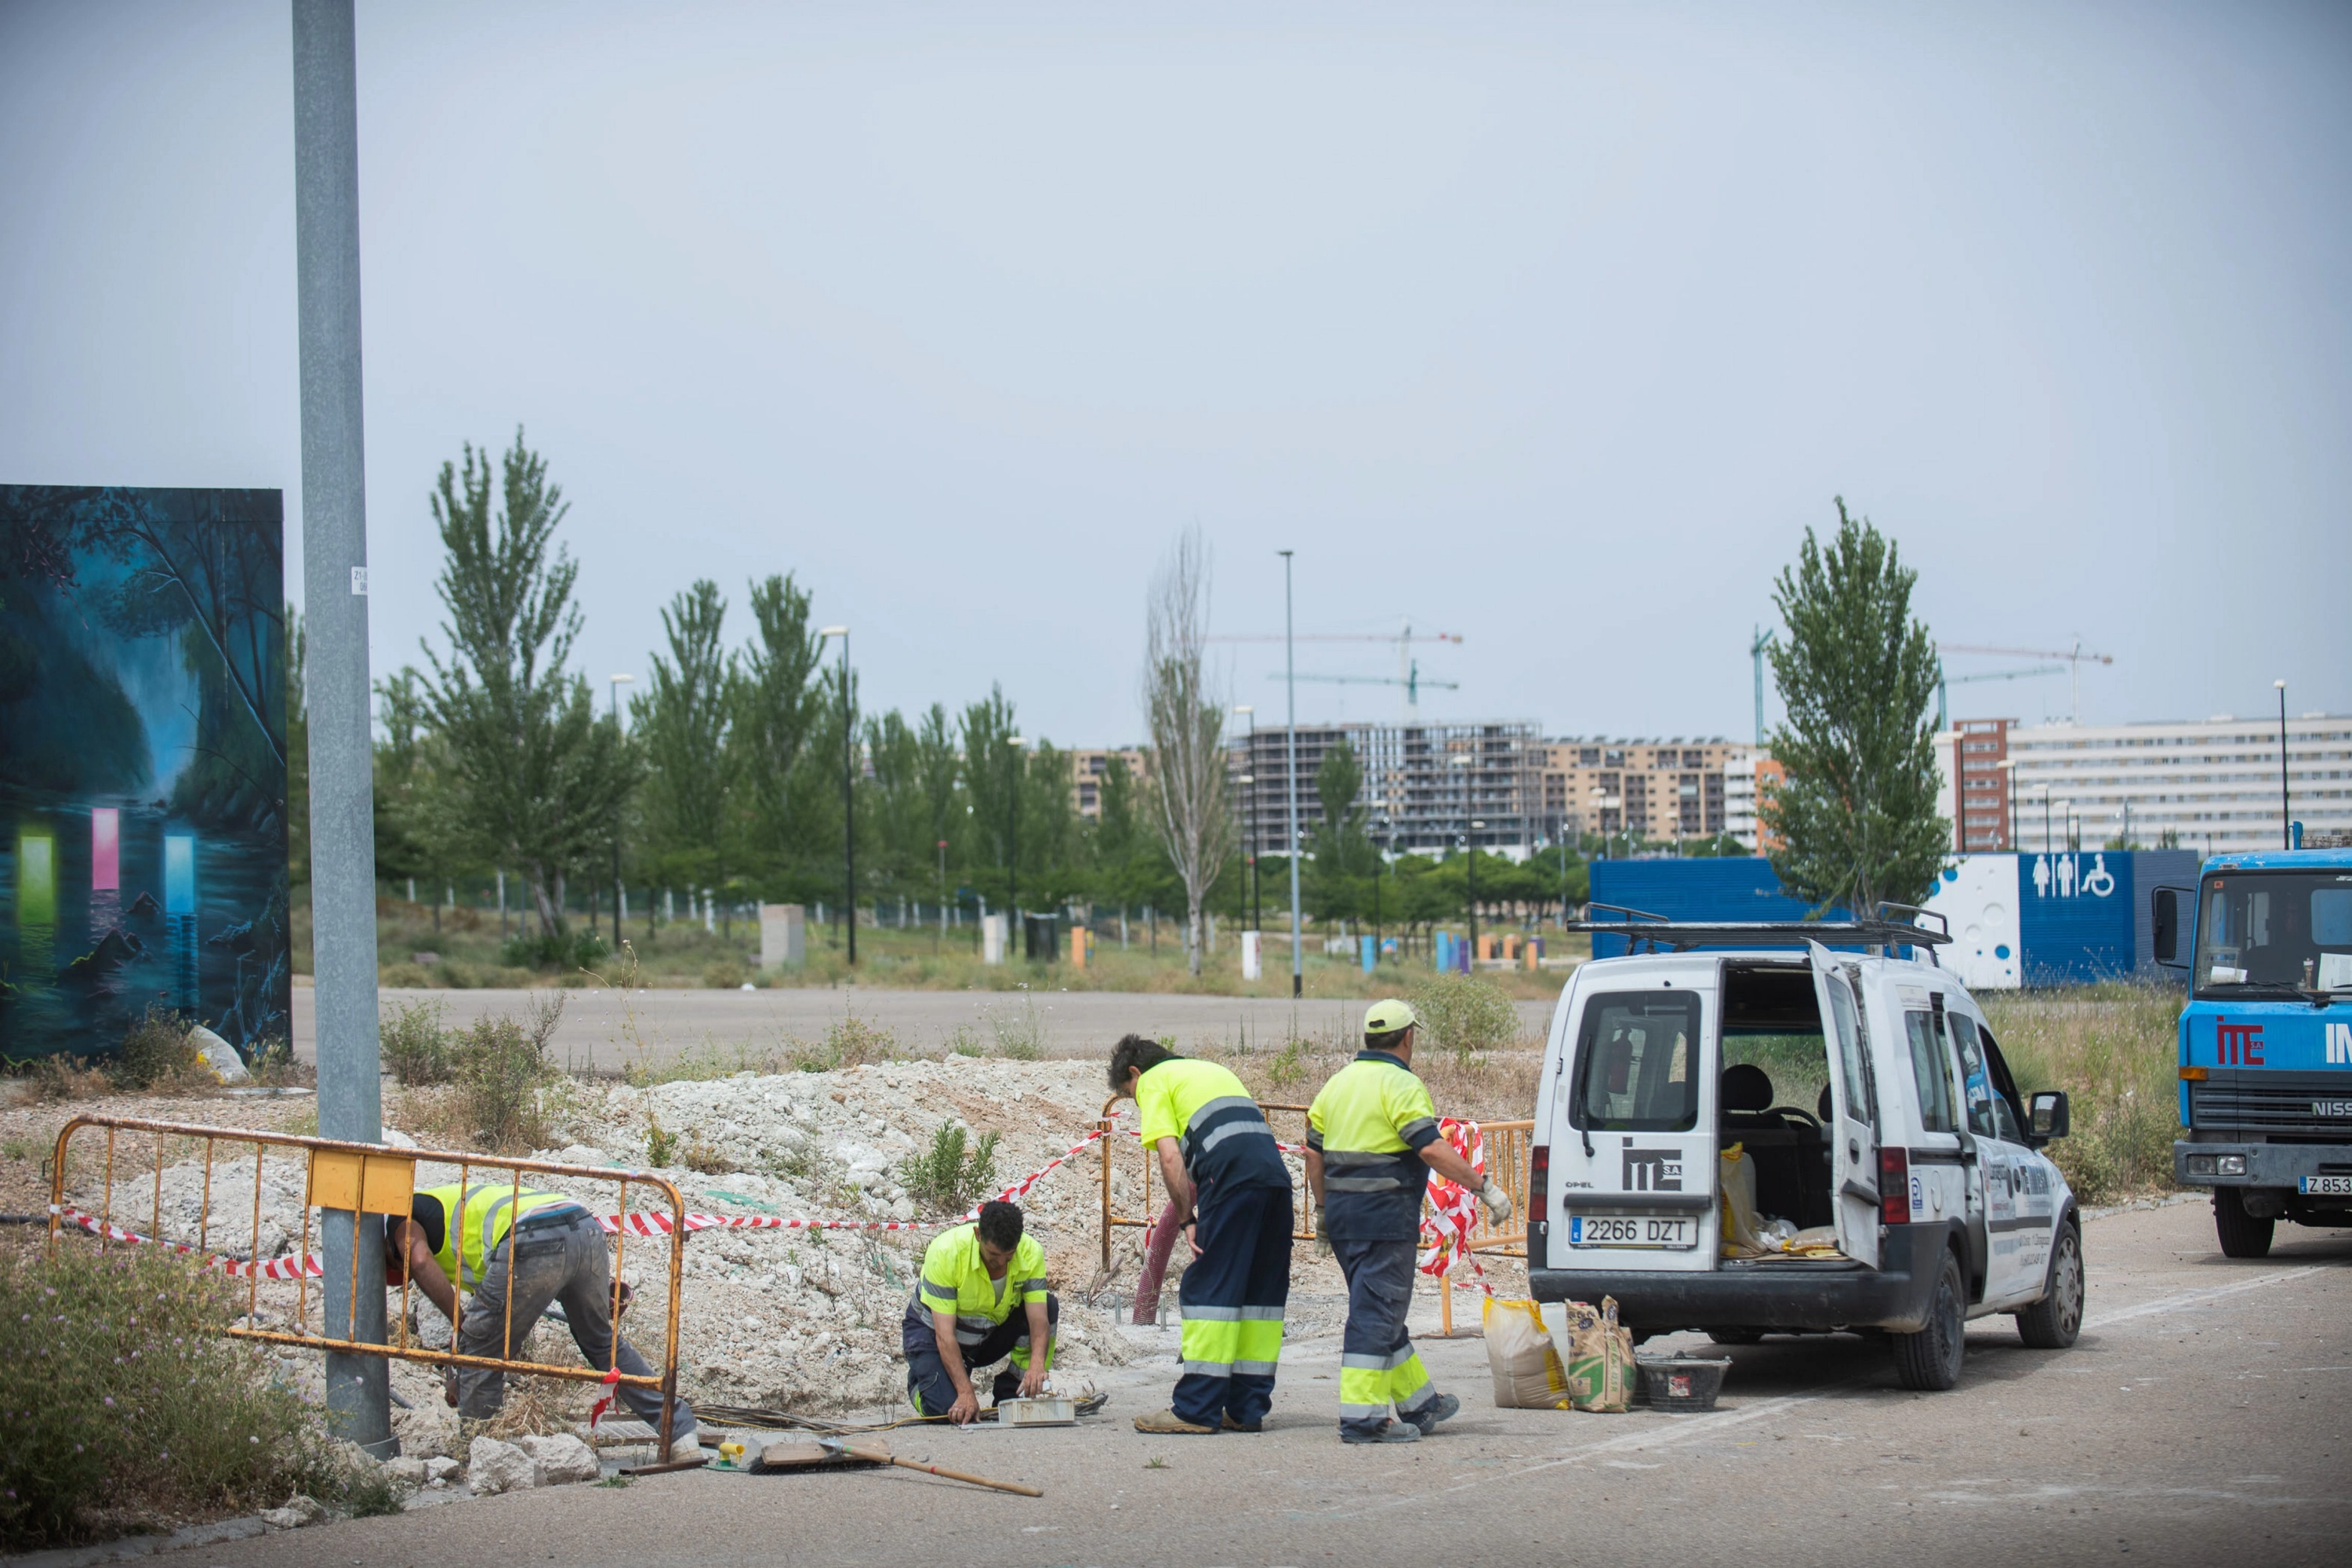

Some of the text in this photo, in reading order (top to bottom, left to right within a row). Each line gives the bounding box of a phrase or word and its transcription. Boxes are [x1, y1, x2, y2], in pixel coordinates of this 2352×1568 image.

[1663, 1165, 1682, 1175] S.A.
[2309, 1178, 2351, 1192] Z 853
[1587, 1220, 1686, 1240] 2266 DZT
